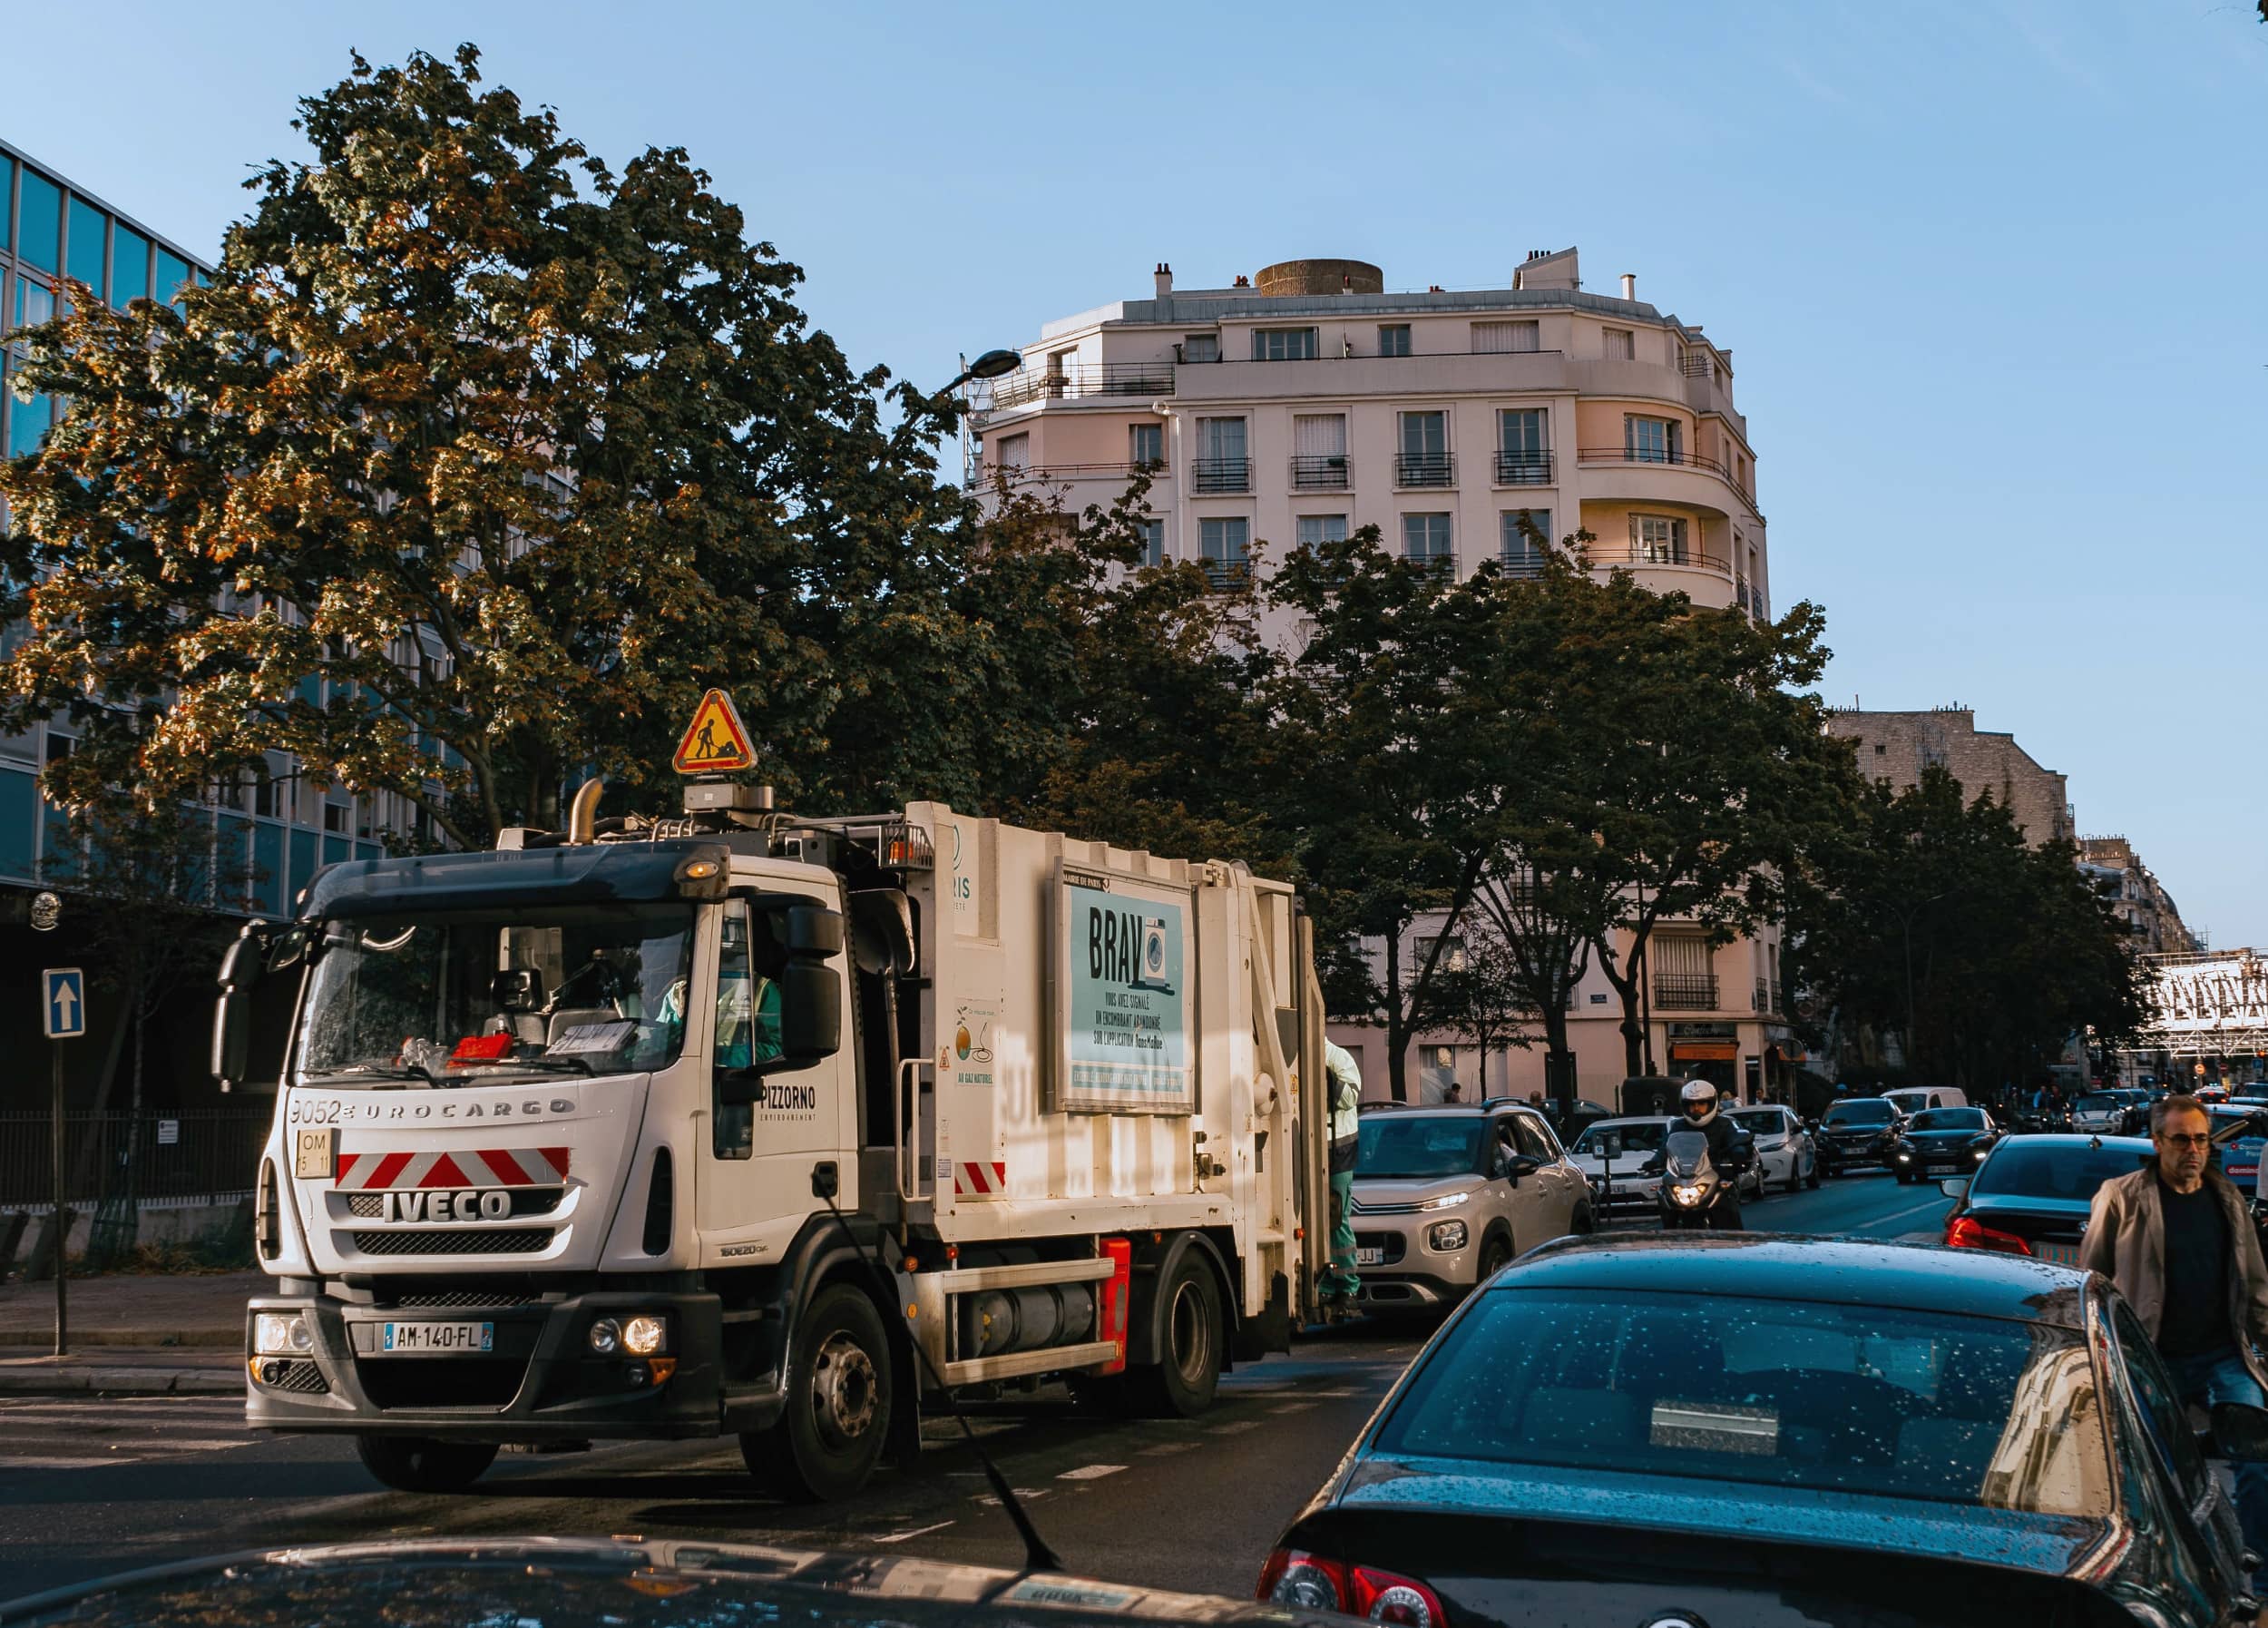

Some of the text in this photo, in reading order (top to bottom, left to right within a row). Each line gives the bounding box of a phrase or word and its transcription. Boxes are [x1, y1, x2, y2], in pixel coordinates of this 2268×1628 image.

[1087, 878, 1101, 888] PARIS
[1090, 907, 1143, 985] BRAV
[760, 1085, 816, 1109] PIZZORNO
[343, 1098, 576, 1120] EUROCARGO
[303, 1134, 326, 1151] OM
[384, 1191, 512, 1223] IVECO
[397, 1327, 478, 1348] AM-140-FL
